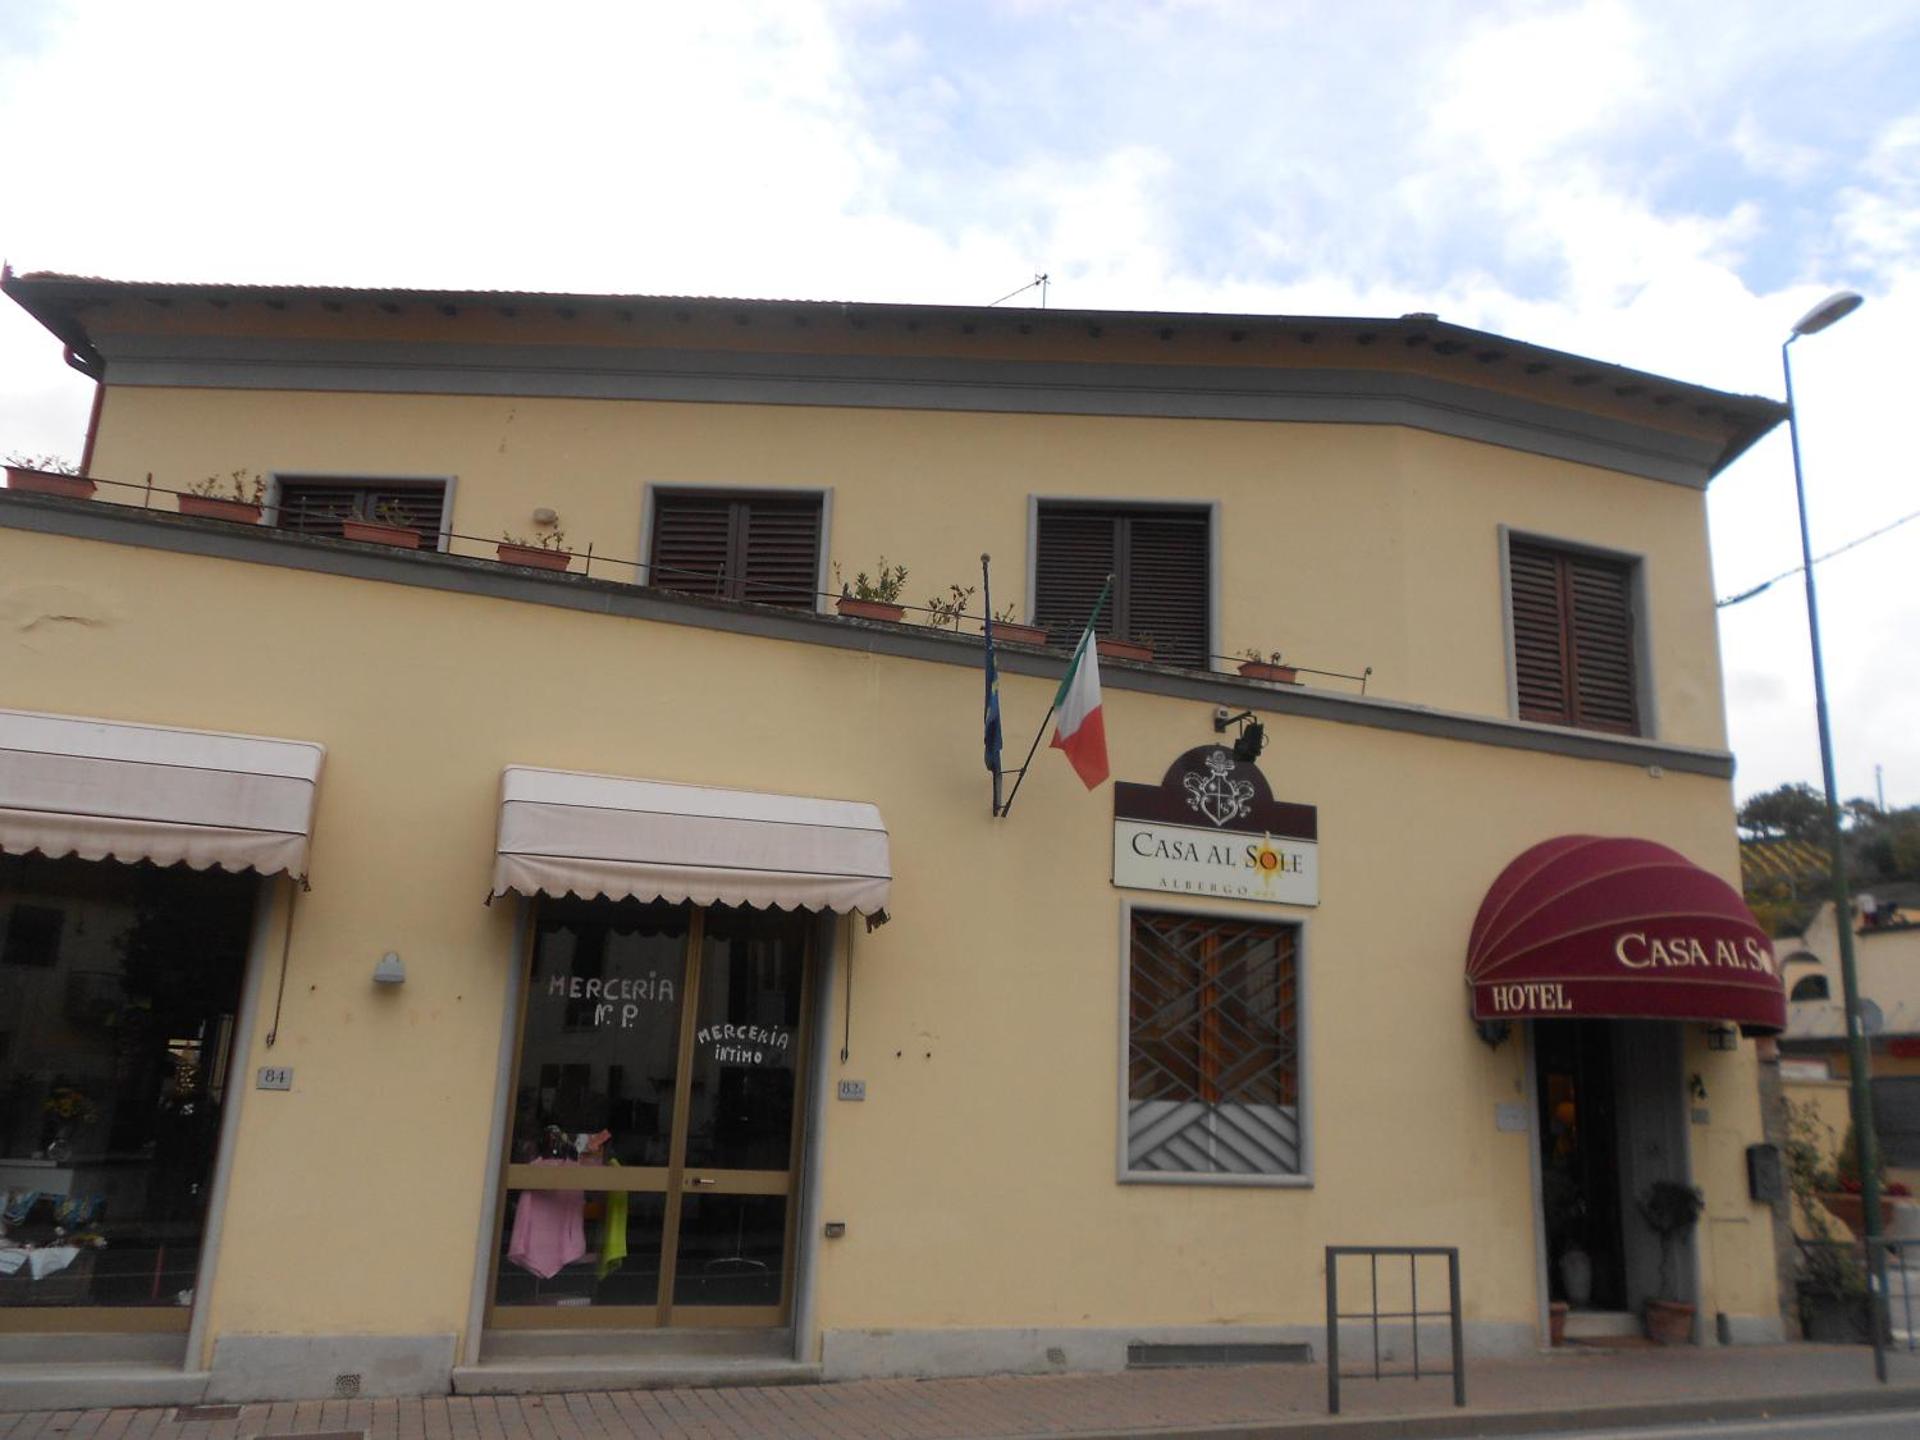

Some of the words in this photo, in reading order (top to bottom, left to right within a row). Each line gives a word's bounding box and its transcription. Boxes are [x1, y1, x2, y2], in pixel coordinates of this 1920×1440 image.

[1131, 831, 1199, 864] CASA
[1207, 845, 1236, 868] AL
[1244, 845, 1303, 874] SOLE
[1159, 877, 1248, 896] ALBERGO
[1615, 932, 1711, 970] CASA
[1716, 939, 1747, 969] AL
[1492, 984, 1572, 1011] HOTEL
[265, 1068, 285, 1084] 84
